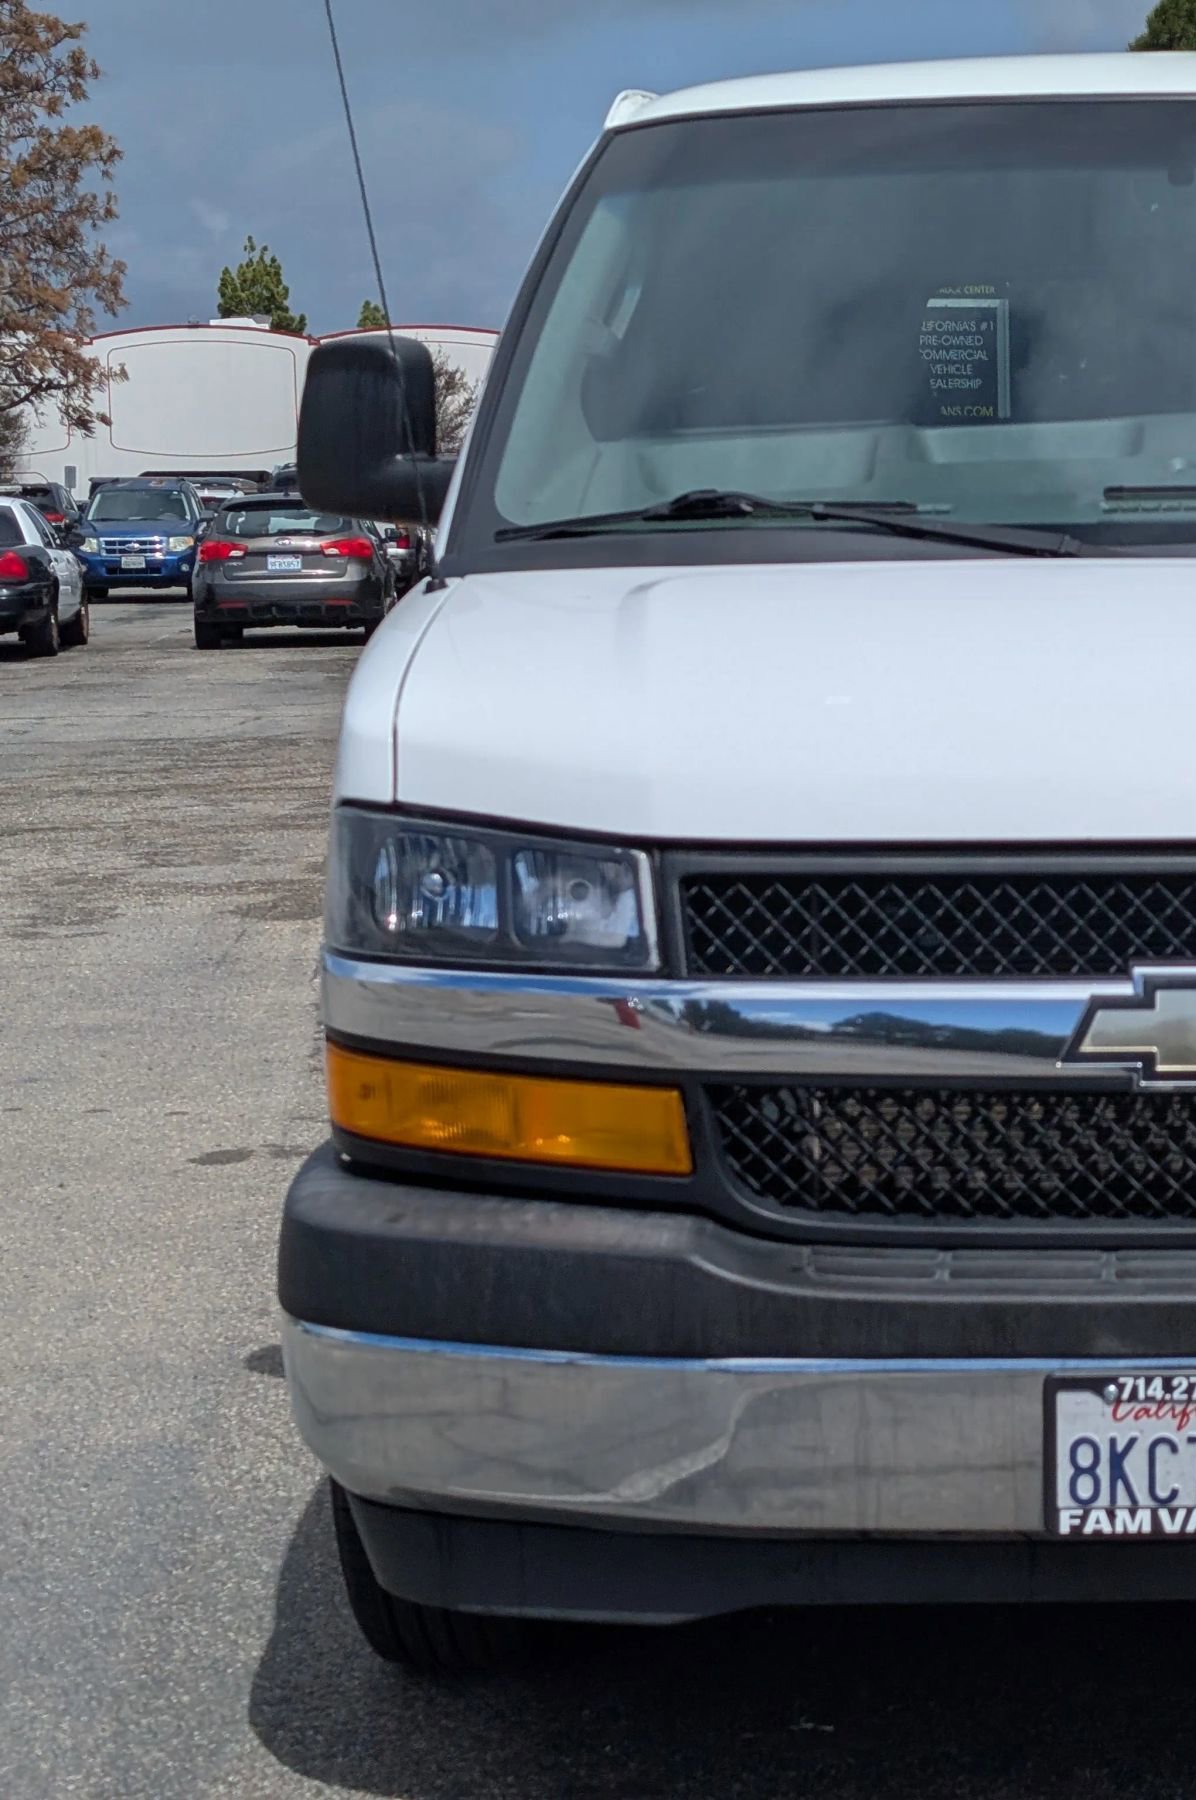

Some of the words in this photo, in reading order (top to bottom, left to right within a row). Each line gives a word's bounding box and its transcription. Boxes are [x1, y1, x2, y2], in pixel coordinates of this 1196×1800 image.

[964, 285, 995, 295] CENTER
[921, 321, 977, 332] LIFORNIA'S
[919, 335, 984, 346] PRE-OWNED
[930, 364, 973, 375] VEHICLE
[930, 379, 983, 390] EALERSHIP
[941, 406, 994, 417] ANS.COM
[1058, 1508, 1150, 1535] FAM
